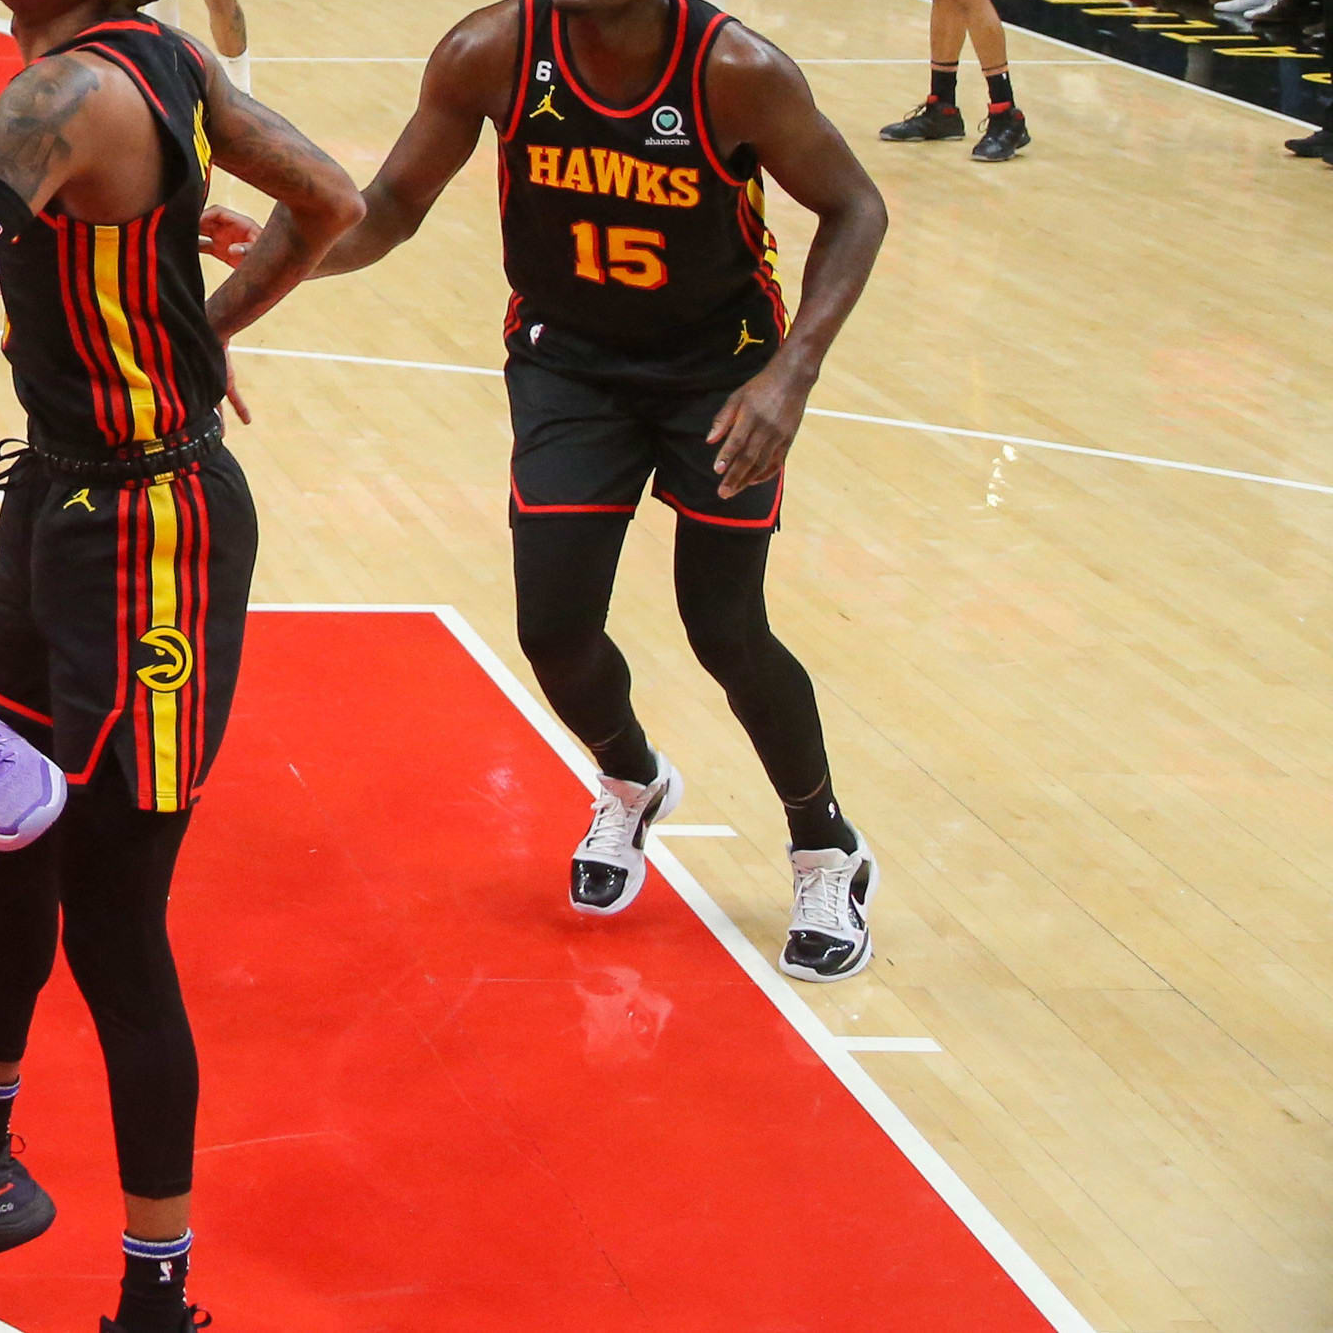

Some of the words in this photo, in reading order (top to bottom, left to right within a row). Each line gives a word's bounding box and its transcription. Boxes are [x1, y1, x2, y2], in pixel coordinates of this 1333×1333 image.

[535, 60, 552, 82] 6
[644, 136, 691, 146] sharecare
[527, 144, 701, 208] HAWKS
[572, 218, 669, 291] 15
